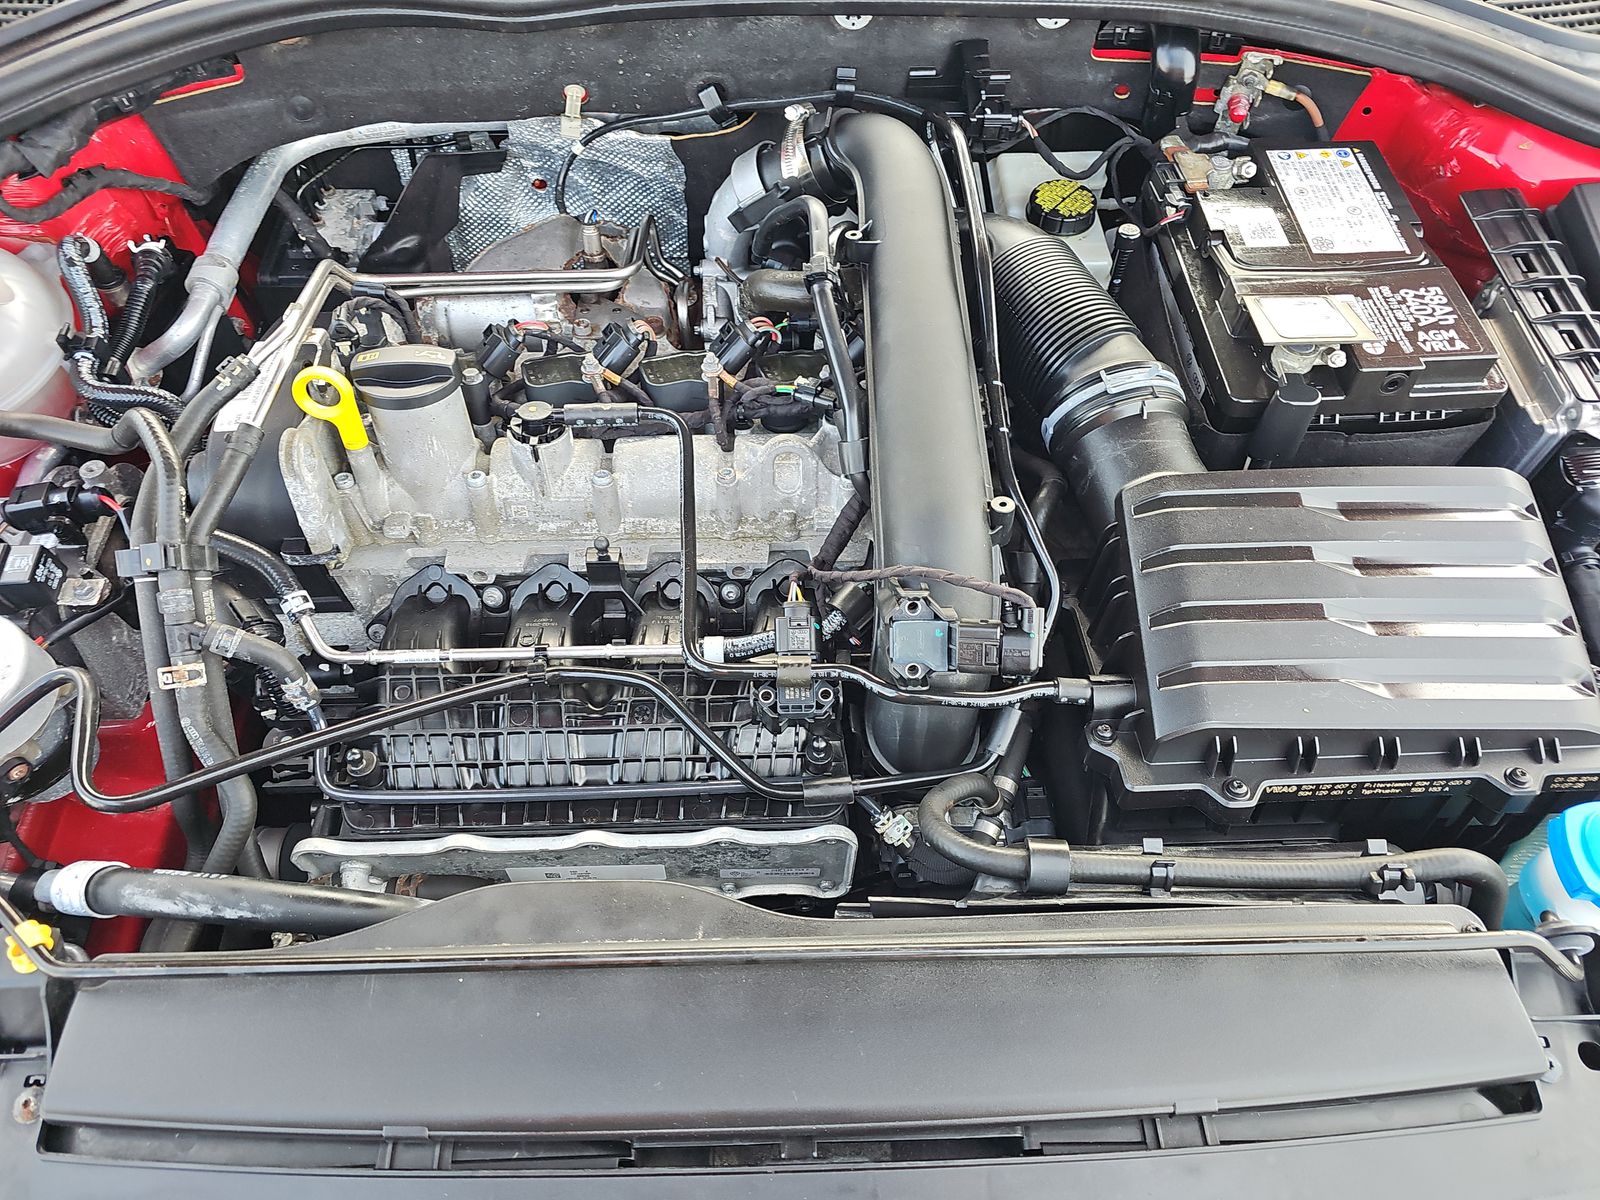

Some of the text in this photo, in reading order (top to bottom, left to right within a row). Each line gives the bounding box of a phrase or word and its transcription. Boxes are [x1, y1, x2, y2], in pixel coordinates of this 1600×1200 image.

[1386, 297, 1401, 309] 915
[1399, 288, 1438, 327] 640A
[1419, 286, 1458, 325] 58Ah
[1417, 329, 1460, 342] AGM
[1417, 339, 1470, 352] VRLA
[1265, 785, 1297, 794] VWAG
